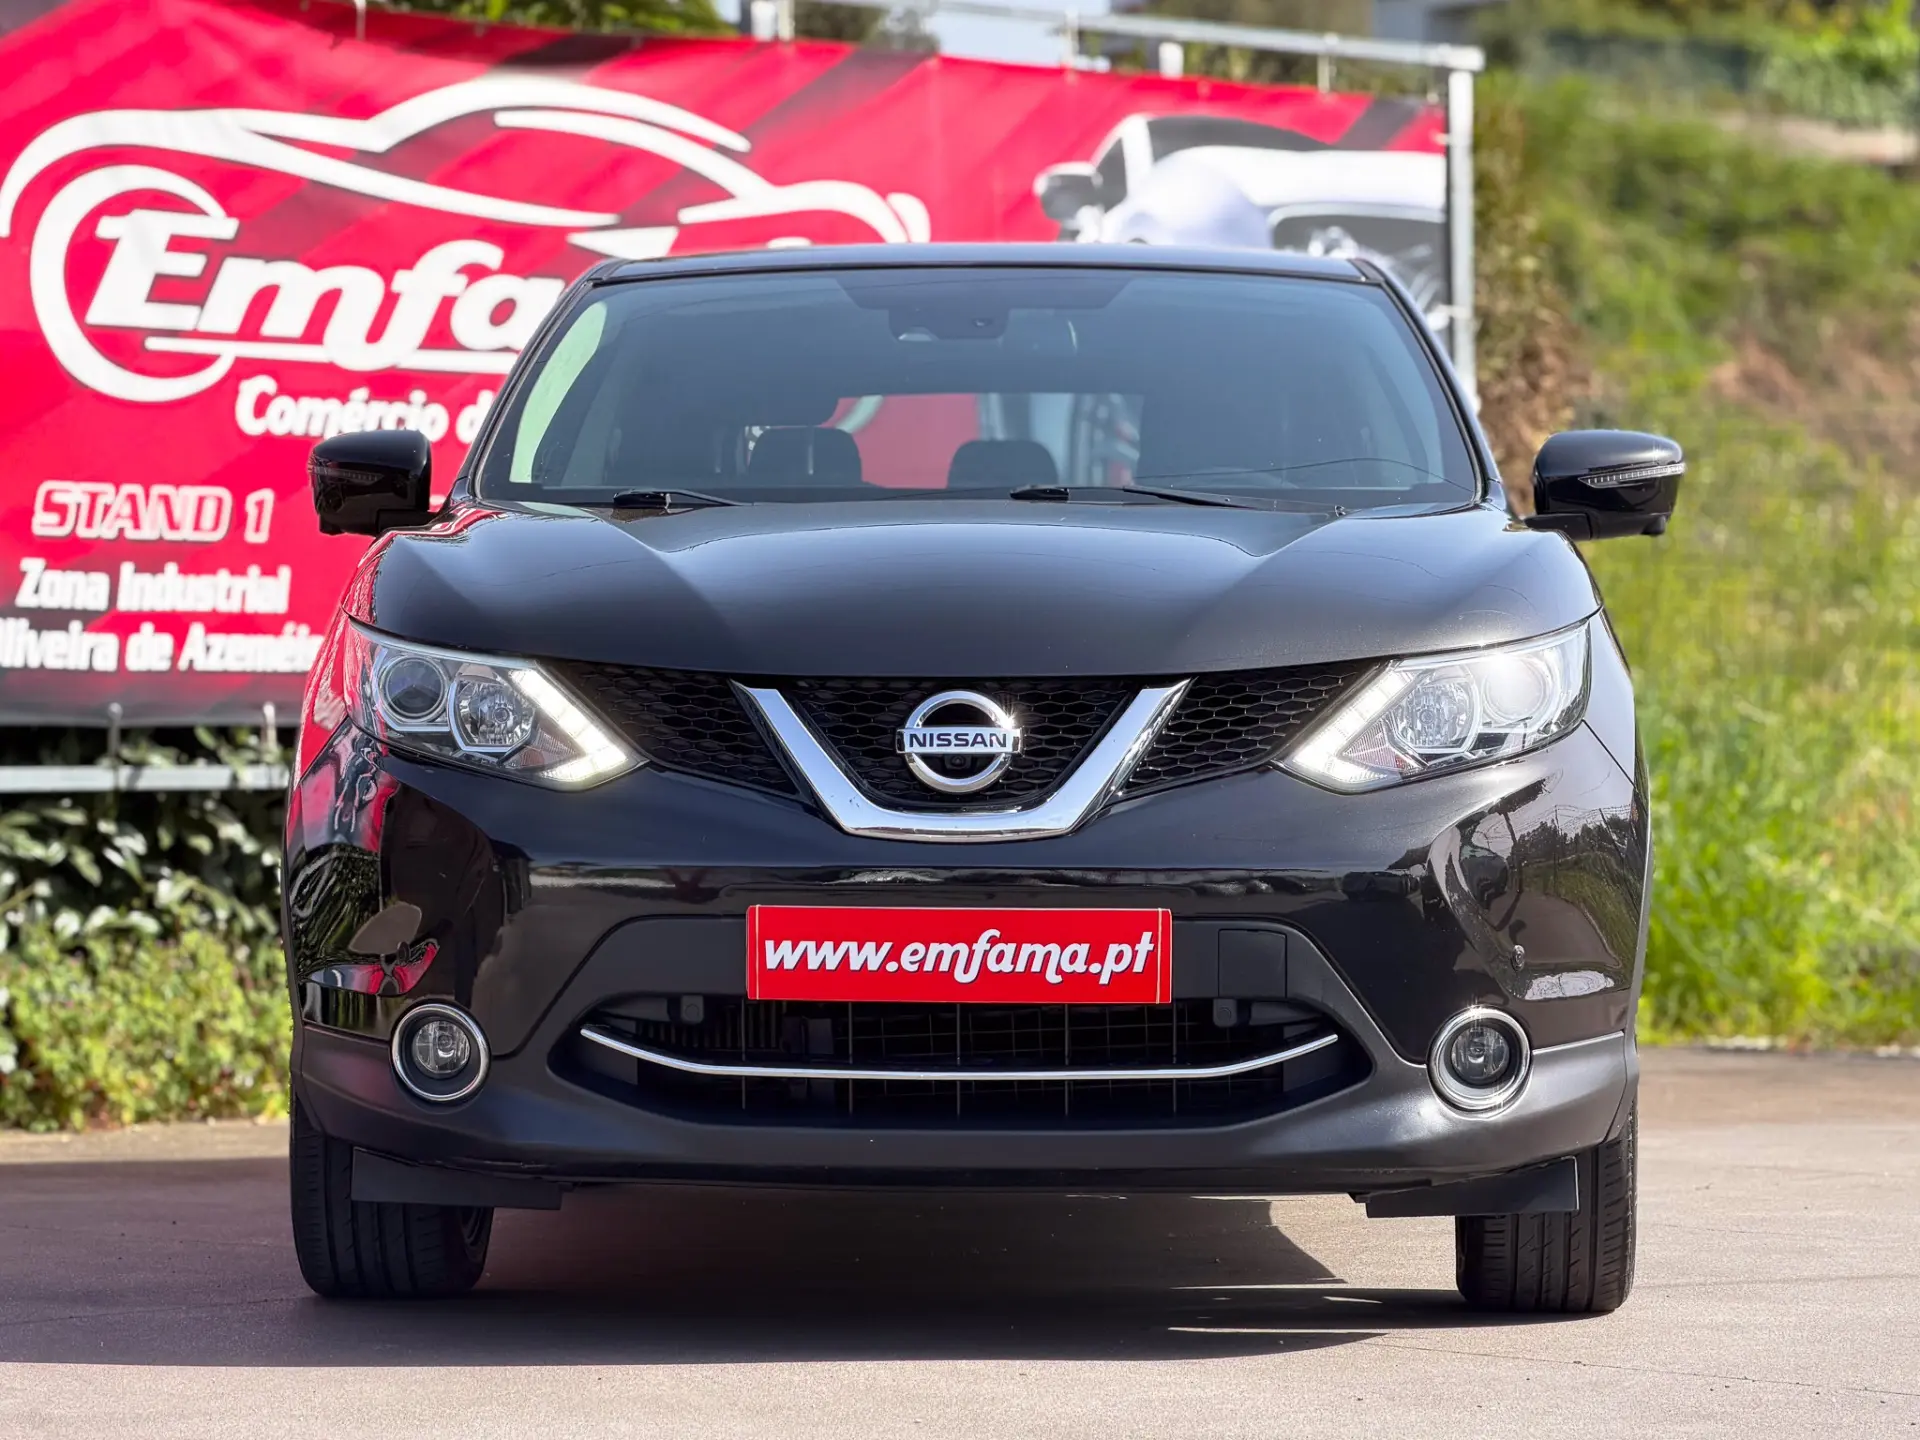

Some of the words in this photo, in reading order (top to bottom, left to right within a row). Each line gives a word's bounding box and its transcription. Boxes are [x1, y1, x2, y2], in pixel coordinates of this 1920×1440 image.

[235, 375, 449, 443] Comércio
[31, 480, 233, 542] STAND
[243, 488, 275, 544] 1
[15, 557, 110, 611] Zona
[116, 561, 292, 614] Industrial
[0, 617, 119, 672] liveira
[125, 621, 174, 671] de
[908, 732, 1007, 748] NISSAN
[764, 928, 1155, 985] www.emfama.pt
